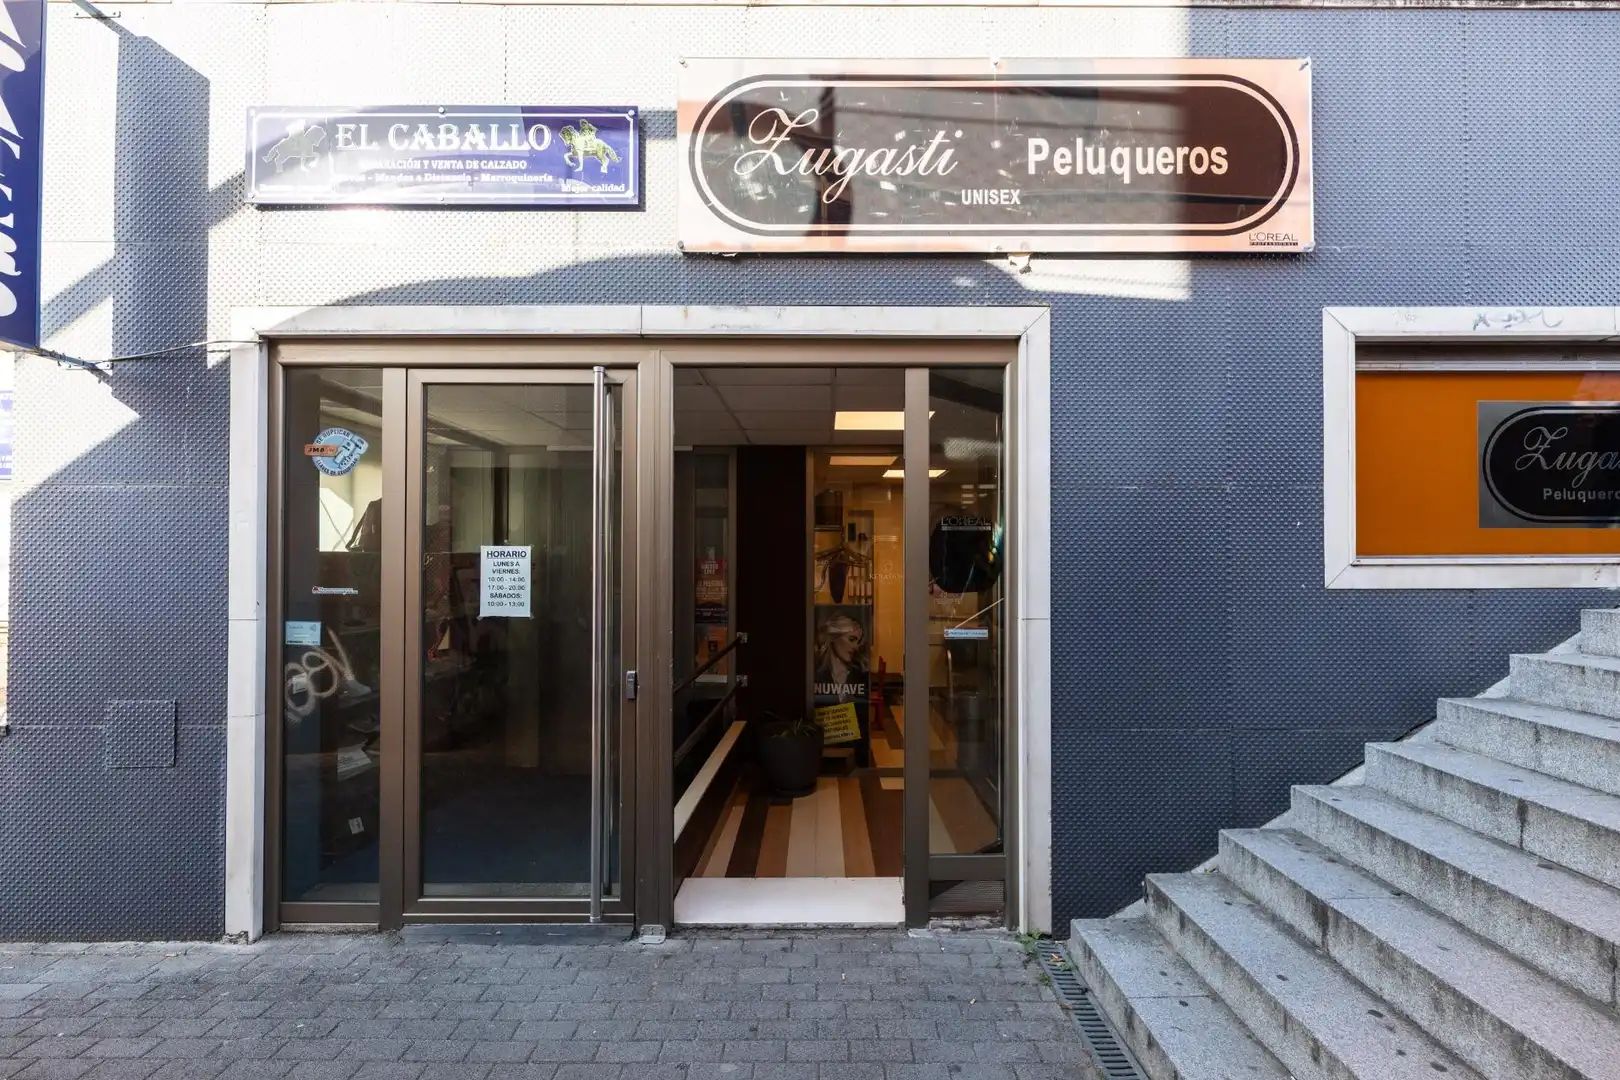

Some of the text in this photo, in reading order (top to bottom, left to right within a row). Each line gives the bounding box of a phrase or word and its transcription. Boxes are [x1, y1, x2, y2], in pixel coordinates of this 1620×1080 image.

[335, 123, 553, 152] EL CABALLO
[733, 108, 1229, 204] Zugasti Peluqueros
[423, 160, 430, 170] Y
[431, 160, 464, 170] VENTA
[465, 160, 479, 170] DE
[480, 159, 527, 170] CALZADO
[424, 173, 472, 182] Distancia
[480, 173, 553, 183] Marroquinería
[591, 184, 625, 192] calidad
[961, 189, 1021, 206] UNISEX
[1515, 426, 1620, 488] Zuga
[814, 683, 865, 695] NUWAVE
